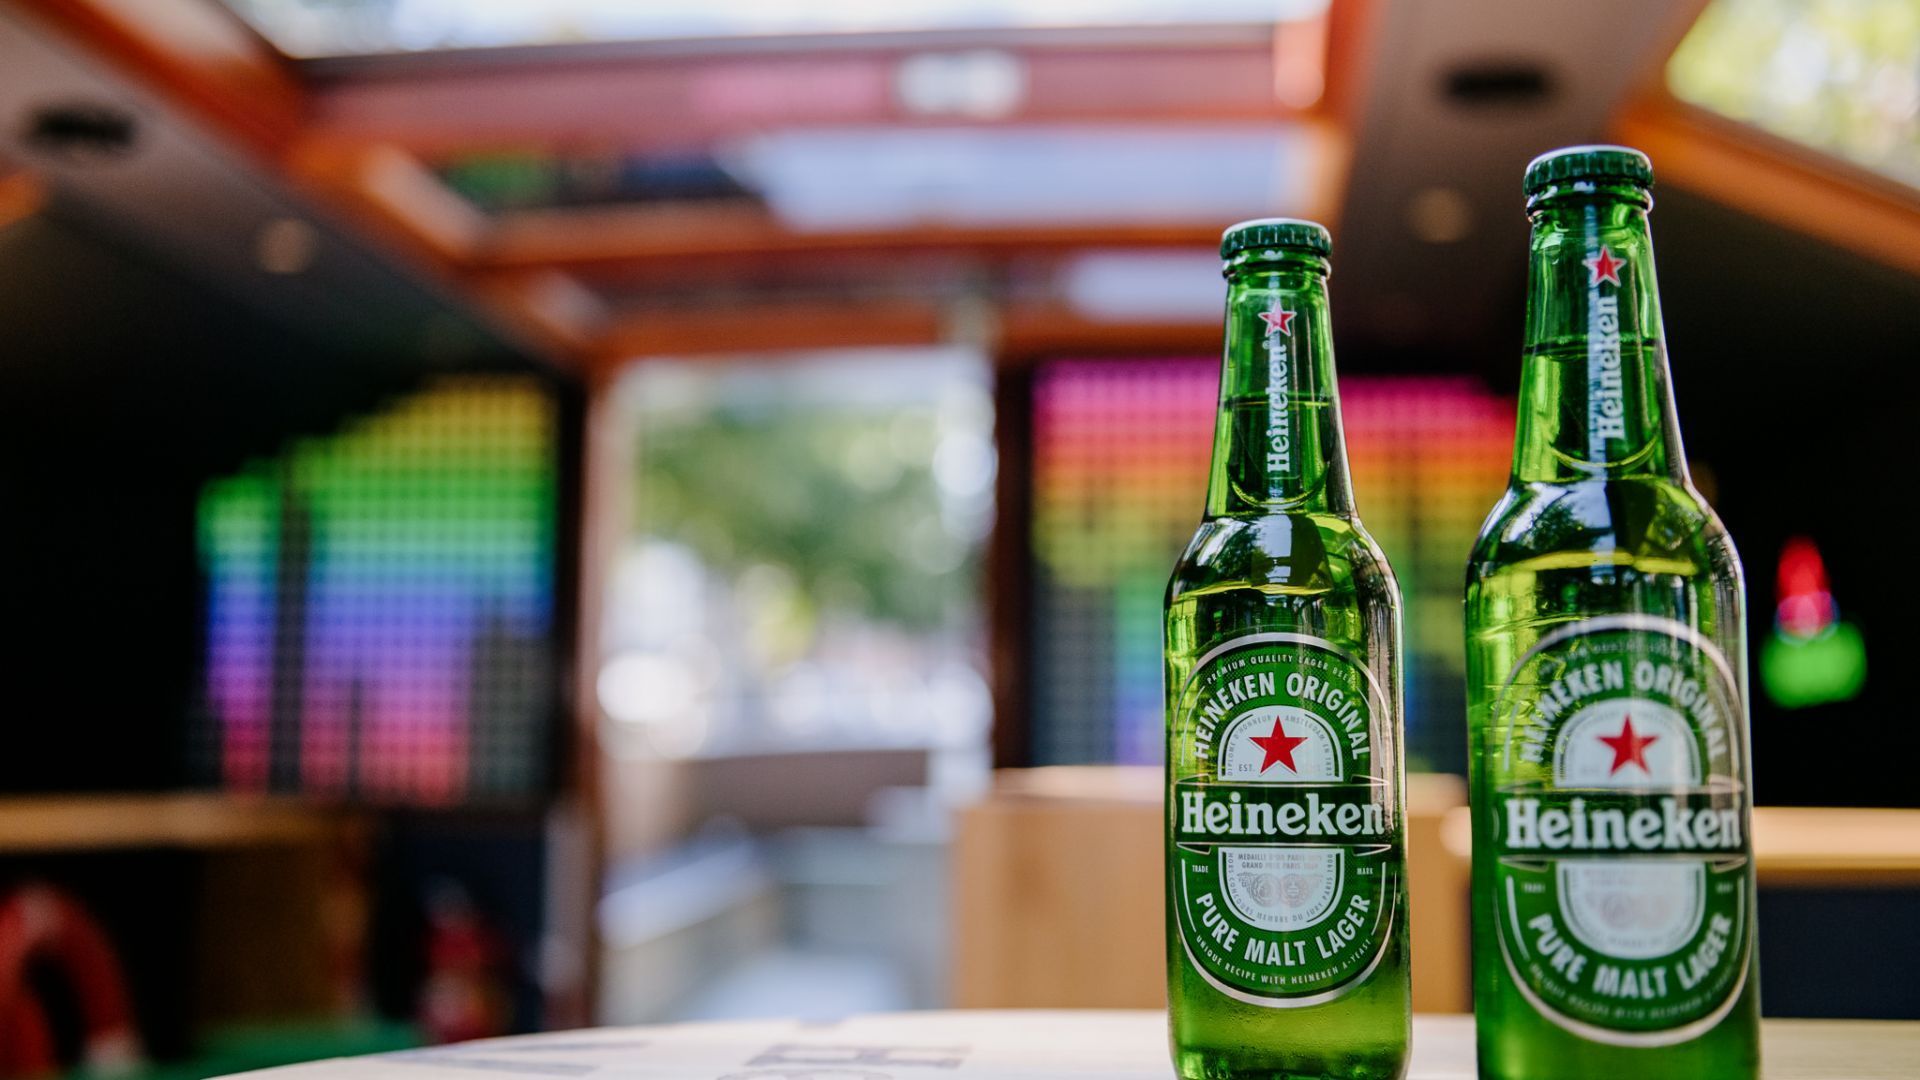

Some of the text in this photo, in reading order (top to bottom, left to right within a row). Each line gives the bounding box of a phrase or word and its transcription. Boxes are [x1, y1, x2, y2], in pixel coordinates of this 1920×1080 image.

[1597, 296, 1625, 440] Heineken
[1266, 344, 1290, 473] Heineken
[1207, 660, 1246, 685] PREMIUM
[1250, 654, 1293, 665] QUALITY
[1298, 655, 1328, 671] LAGER
[1194, 672, 1370, 760] HEINEKEN ORIGINAL
[1520, 660, 1727, 764] HEINEKEN ORIGINAL
[1181, 791, 1385, 835] Heineken
[1505, 797, 1743, 849] Heineken
[1192, 865, 1208, 873] TRADE
[1196, 892, 1371, 967] PURE MALT LAGER
[1196, 936, 1222, 965] UNIQUE
[1224, 963, 1256, 981] RECIPE
[1260, 975, 1286, 984] WITH
[1291, 967, 1338, 985] HEINEKEN
[1528, 913, 1588, 984] PURE
[1592, 964, 1668, 999] MALT
[1675, 912, 1733, 990] LAGER
